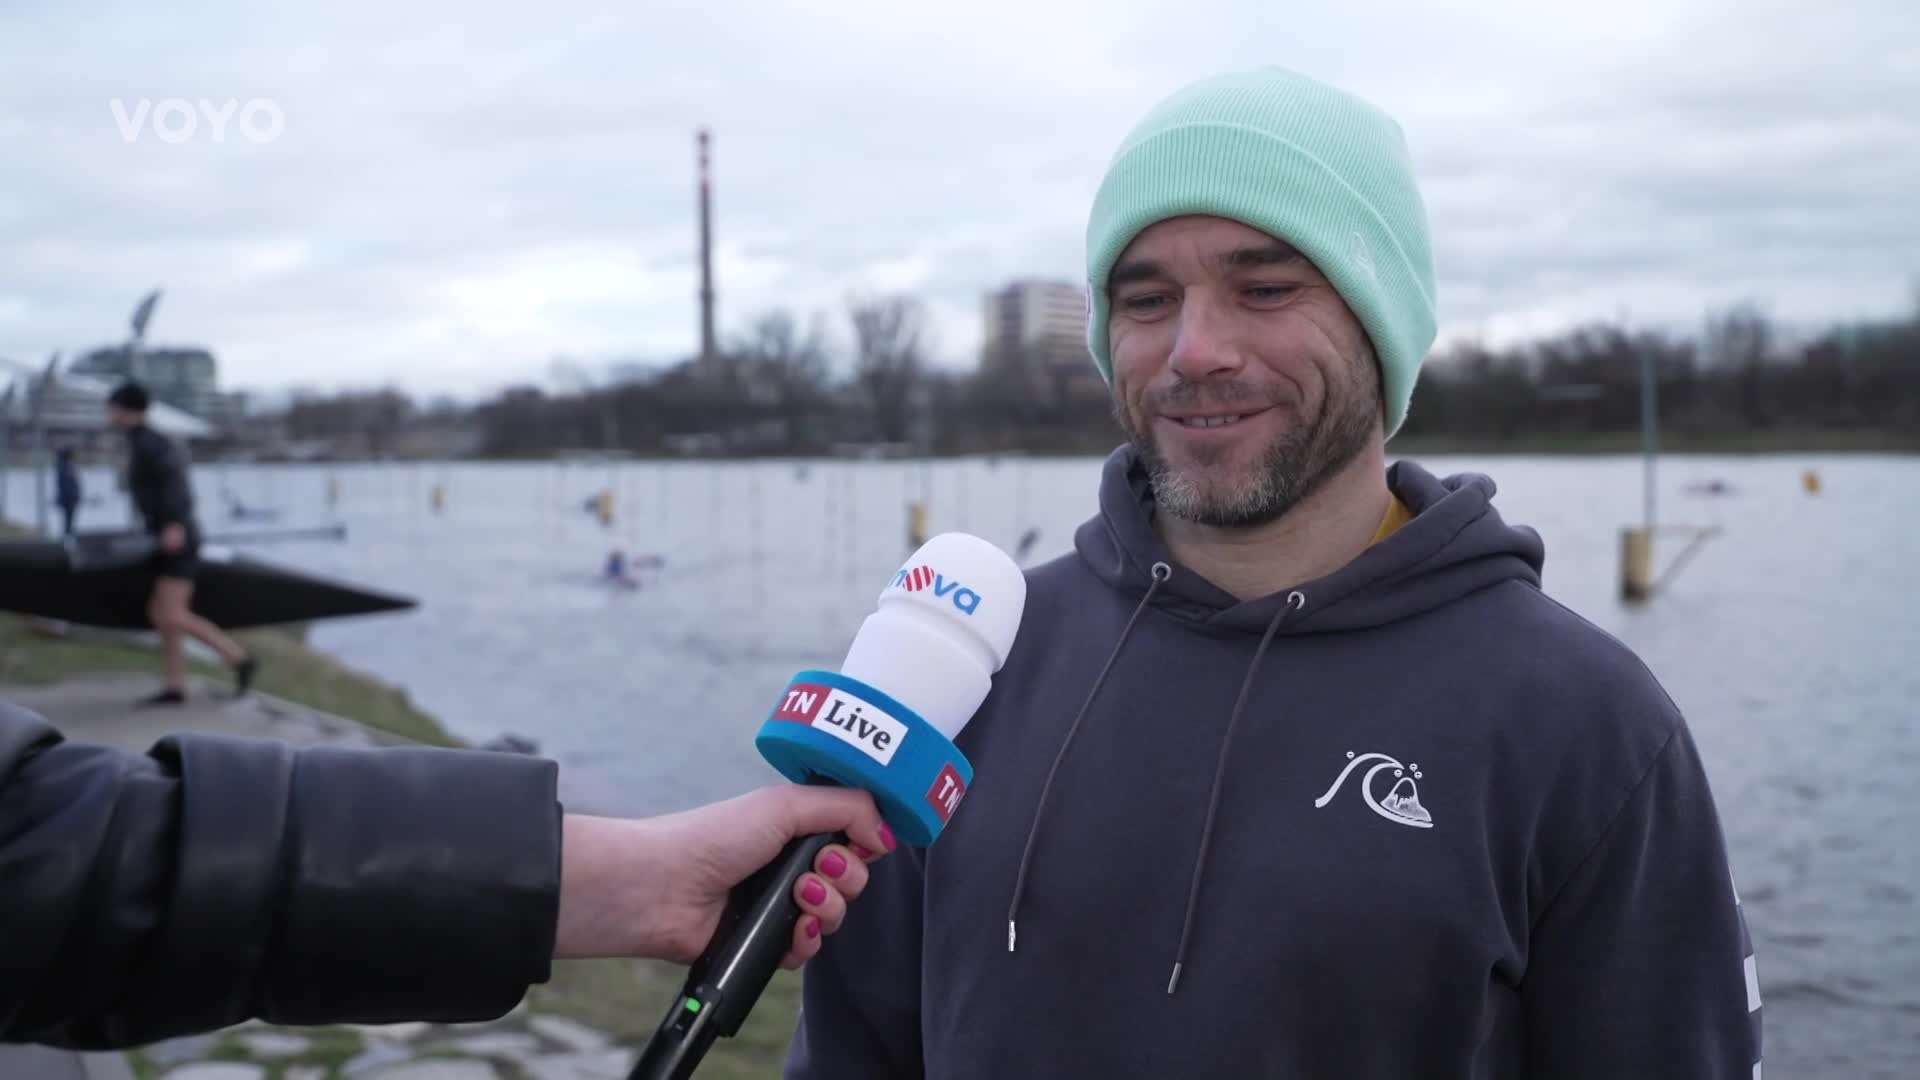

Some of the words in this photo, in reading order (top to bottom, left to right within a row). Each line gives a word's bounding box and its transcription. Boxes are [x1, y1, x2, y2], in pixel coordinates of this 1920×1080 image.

[887, 565, 982, 616] nova
[781, 690, 818, 714] TN
[823, 699, 892, 752] Live
